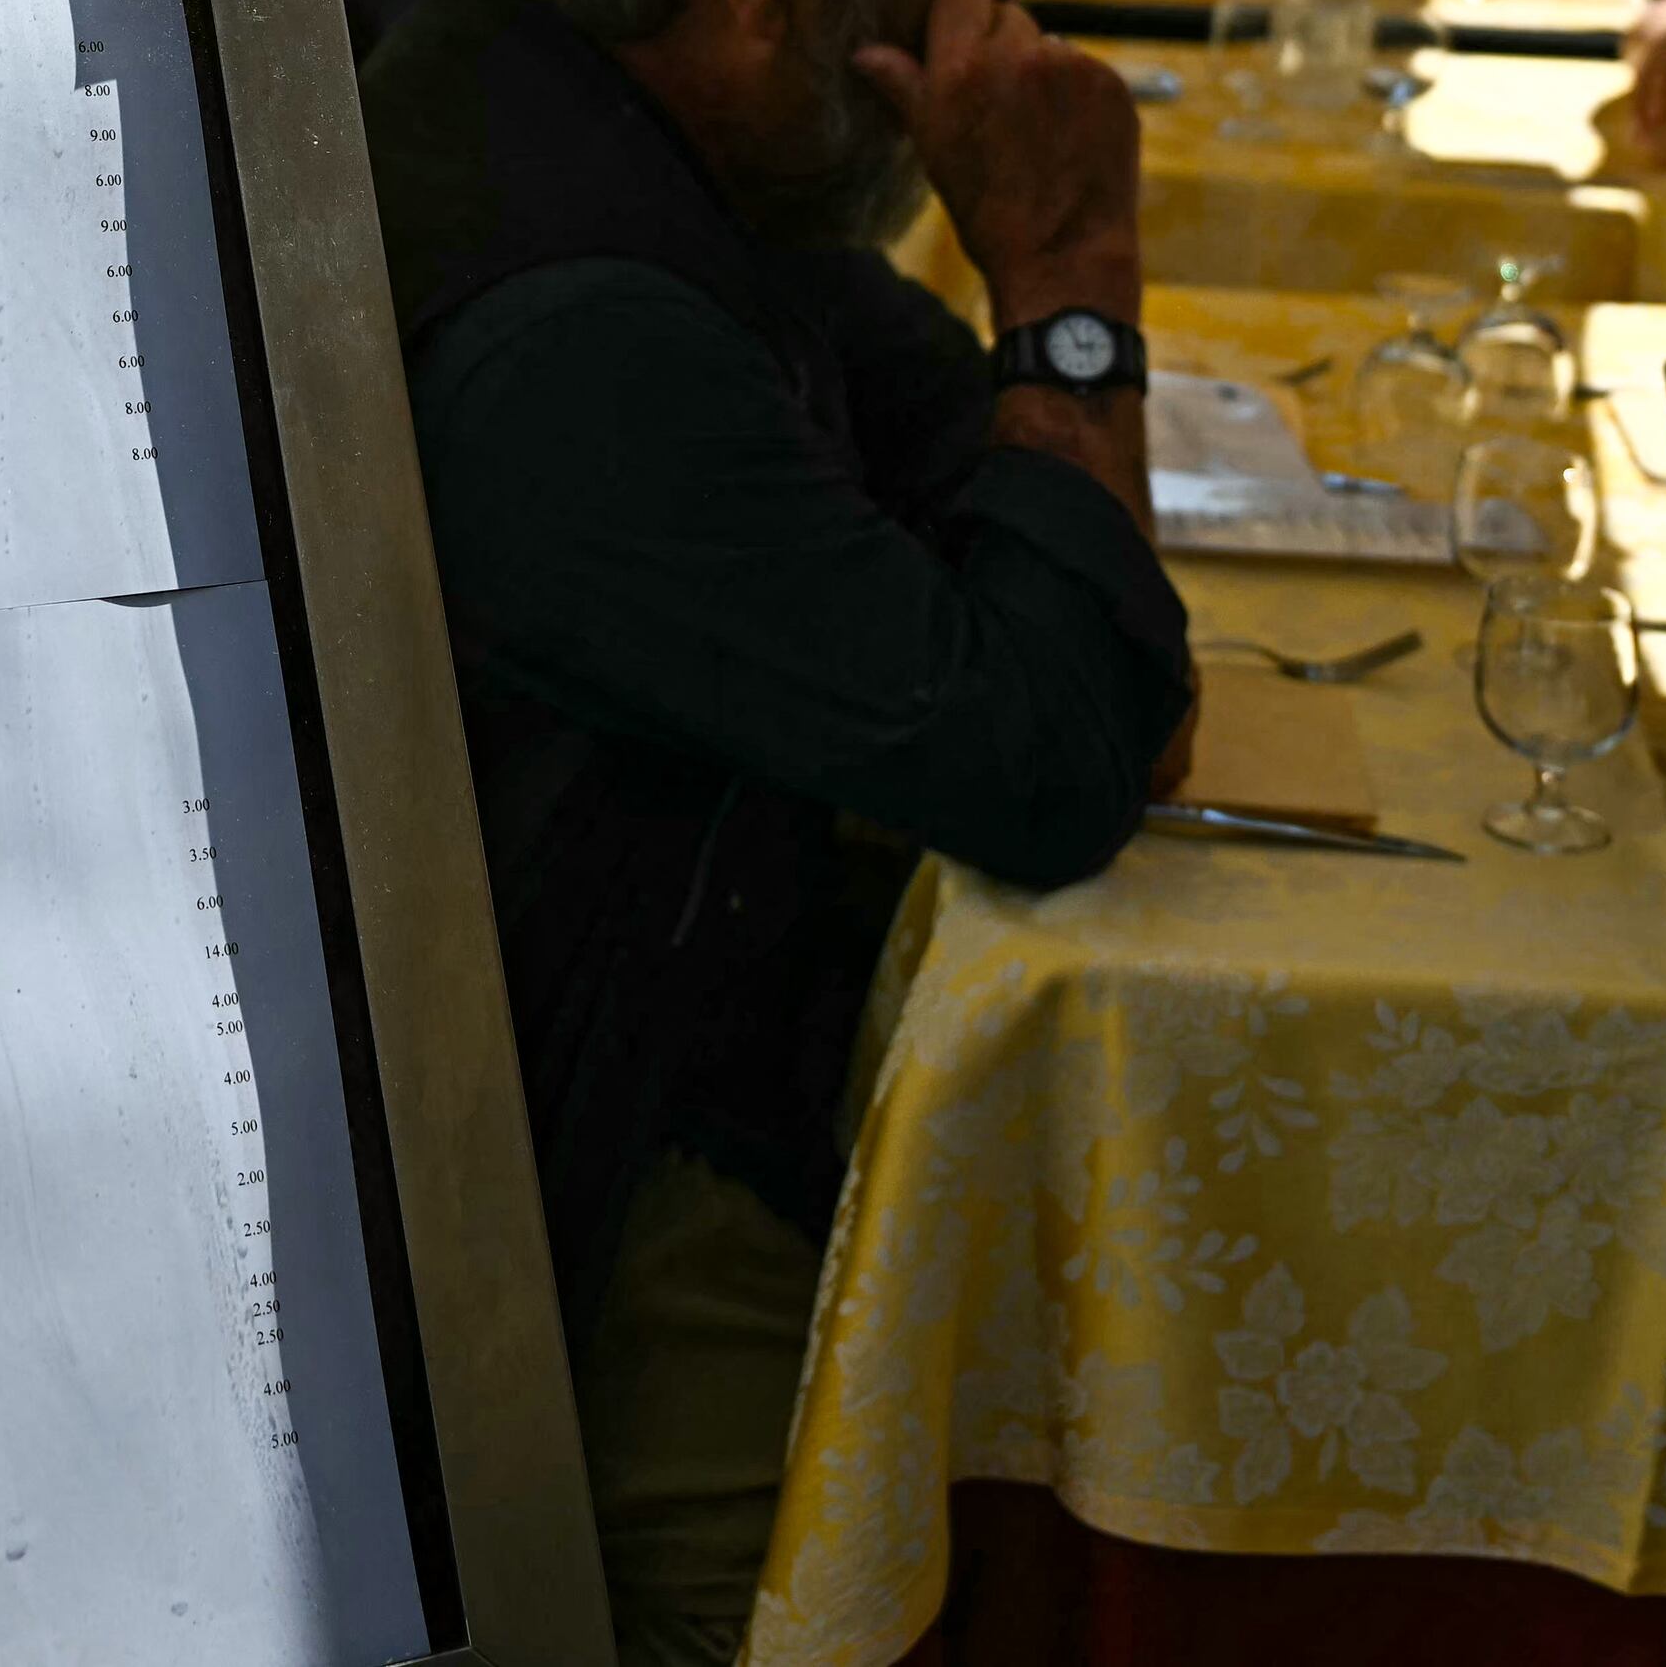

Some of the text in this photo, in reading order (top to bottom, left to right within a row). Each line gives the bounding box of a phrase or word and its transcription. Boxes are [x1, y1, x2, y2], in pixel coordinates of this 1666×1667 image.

[78, 40, 104, 54] 6.00
[85, 85, 110, 96] 8.00
[113, 310, 138, 323] 6.00
[132, 447, 158, 460] 8.00
[183, 798, 209, 813] 3.00
[190, 846, 216, 862] 3.50
[206, 943, 238, 958] 14.00
[244, 1221, 270, 1237] 2.50
